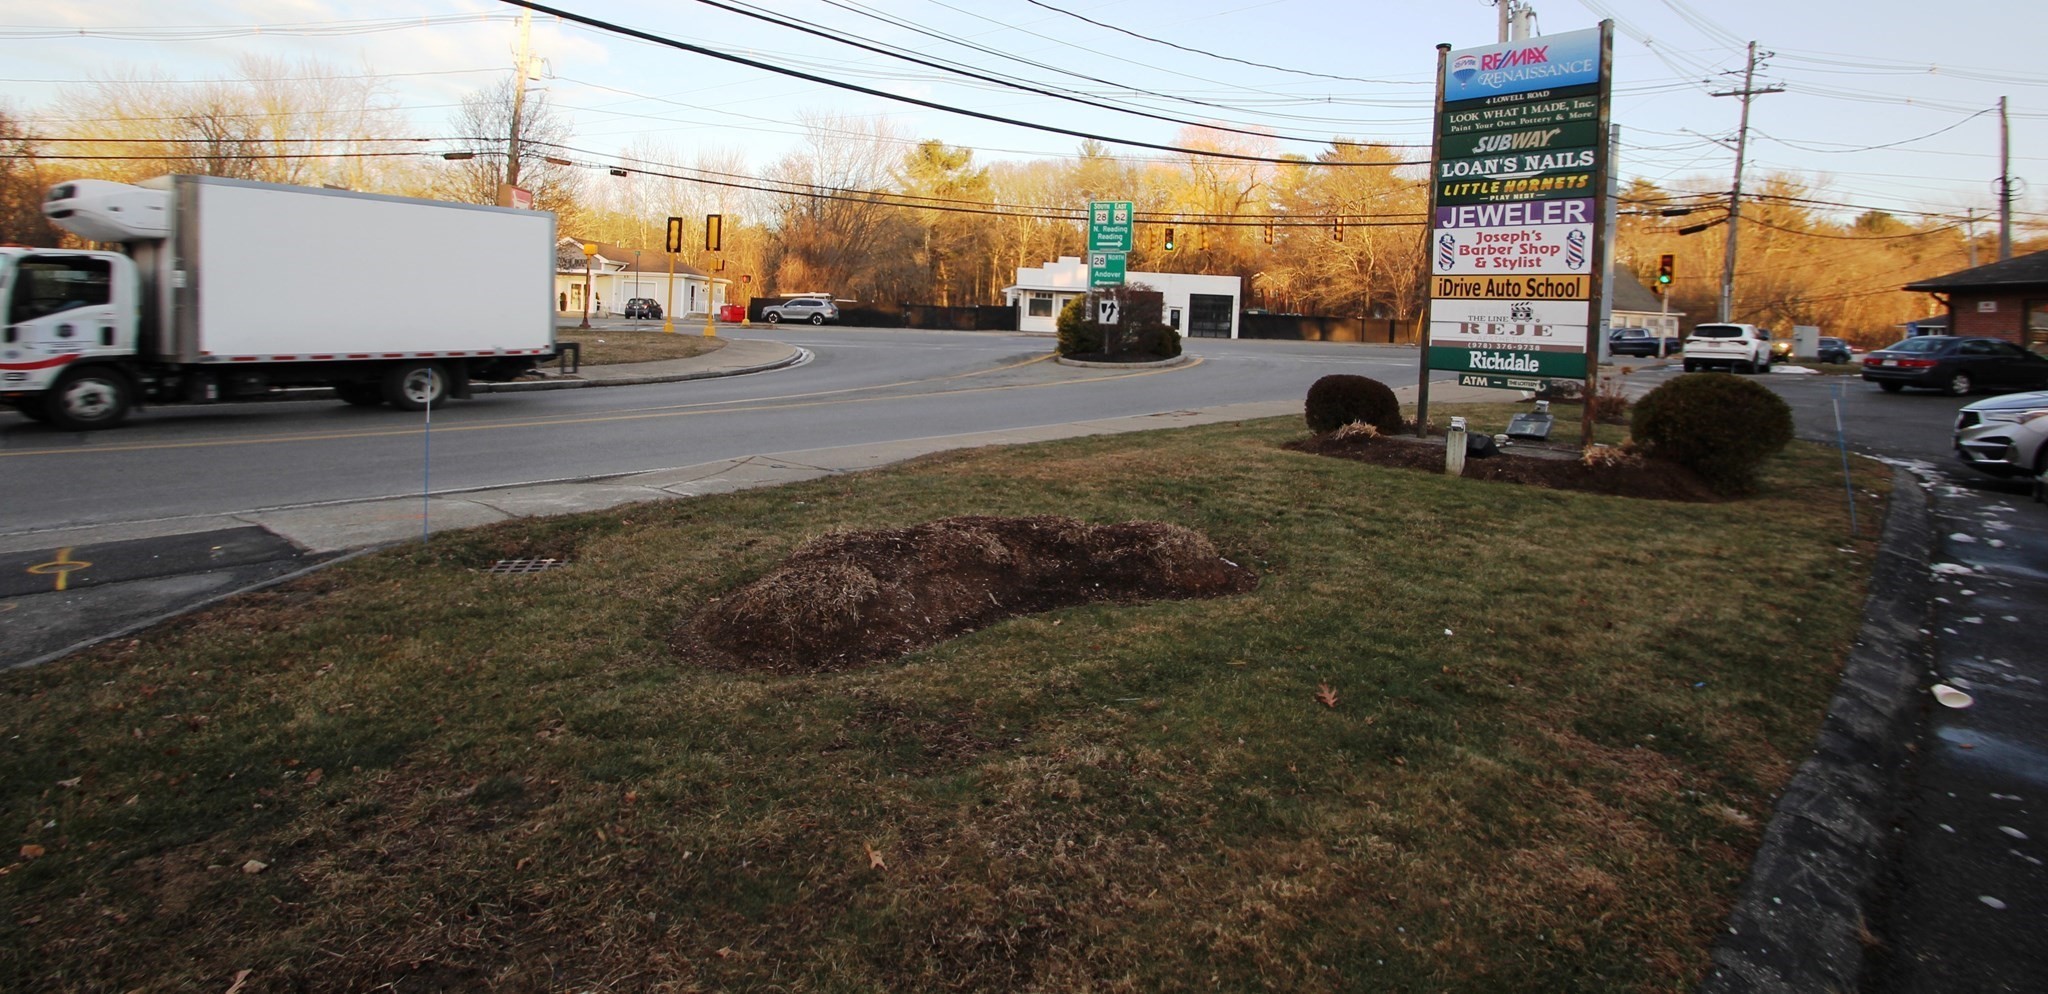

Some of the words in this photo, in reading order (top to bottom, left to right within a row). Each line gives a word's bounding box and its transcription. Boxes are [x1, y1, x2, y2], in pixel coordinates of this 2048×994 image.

[1481, 45, 1549, 71] RE/MAX
[1478, 59, 1593, 88] RENAISSANCE
[1493, 94, 1524, 103] LOWELL
[1527, 91, 1550, 99] ROAD
[1450, 112, 1479, 123] LOOK
[1483, 107, 1519, 119] WHAT
[1522, 107, 1527, 115] I
[1531, 102, 1569, 114] MADE,
[1574, 100, 1595, 109] Inc.
[1520, 117, 1552, 125] Pottery
[1569, 111, 1592, 119] More
[1472, 128, 1561, 154] SUBWAY
[1442, 157, 1518, 178] LOAN'S
[1524, 150, 1594, 171] NAILS
[1444, 182, 1501, 197] LITTLE
[1504, 175, 1589, 193] HORNETS
[1513, 192, 1535, 200] NEST
[1096, 213, 1107, 222] 28
[1115, 213, 1126, 222] 62
[1442, 200, 1586, 228] JEWELER
[1097, 233, 1123, 241] Reading
[1103, 226, 1128, 234] Reading
[1476, 230, 1542, 245] Joseph's
[1459, 244, 1513, 256] Barber
[1519, 243, 1560, 257] Shop
[1093, 257, 1105, 266] 28
[1475, 257, 1487, 268] &
[1493, 257, 1542, 270] Stylist
[1094, 270, 1121, 278] Andover
[1438, 278, 1481, 297] iDrive
[1485, 279, 1520, 297] Auto
[1525, 277, 1580, 297] School
[1460, 322, 1552, 336] REJE
[1469, 351, 1539, 373] Richdale
[1462, 376, 1488, 386] ATM
